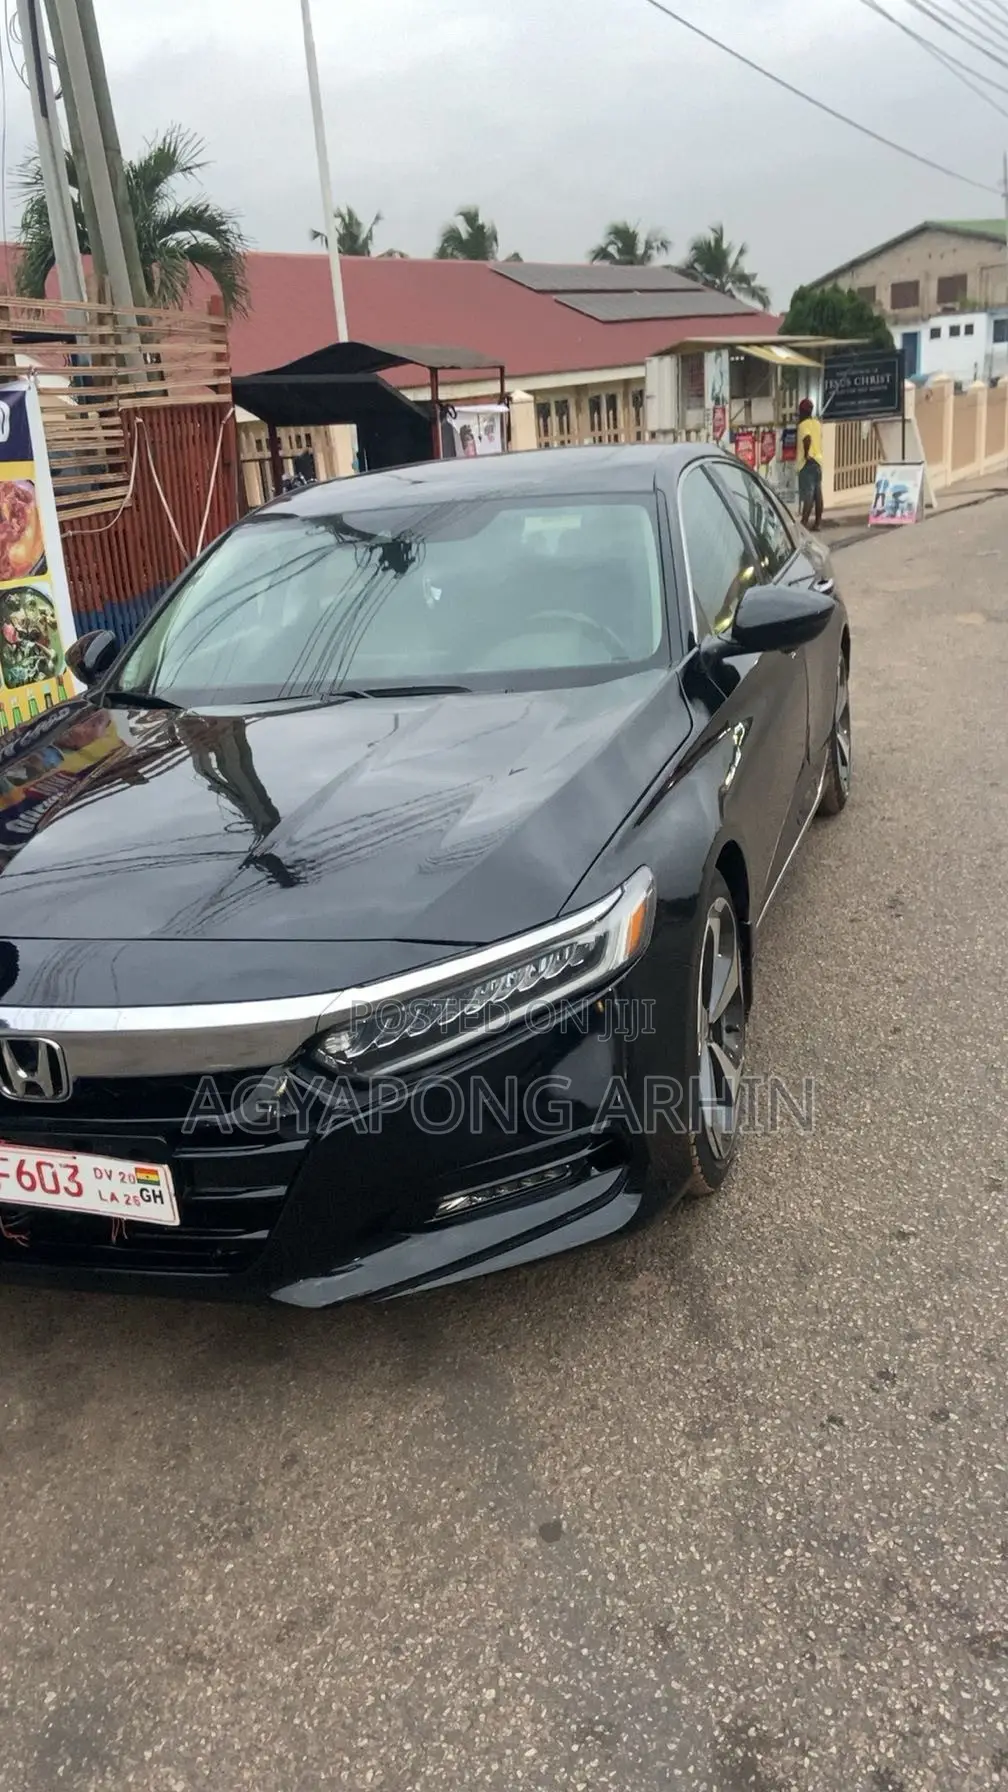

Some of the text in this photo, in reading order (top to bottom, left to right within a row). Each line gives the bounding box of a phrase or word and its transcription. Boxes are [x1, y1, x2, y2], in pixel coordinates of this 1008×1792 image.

[824, 377, 852, 391] JESUS
[853, 373, 892, 386] CHRIST
[93, 1167, 136, 1185] DV 20
[98, 1189, 120, 1203] LA
[140, 1187, 165, 1205] GH
